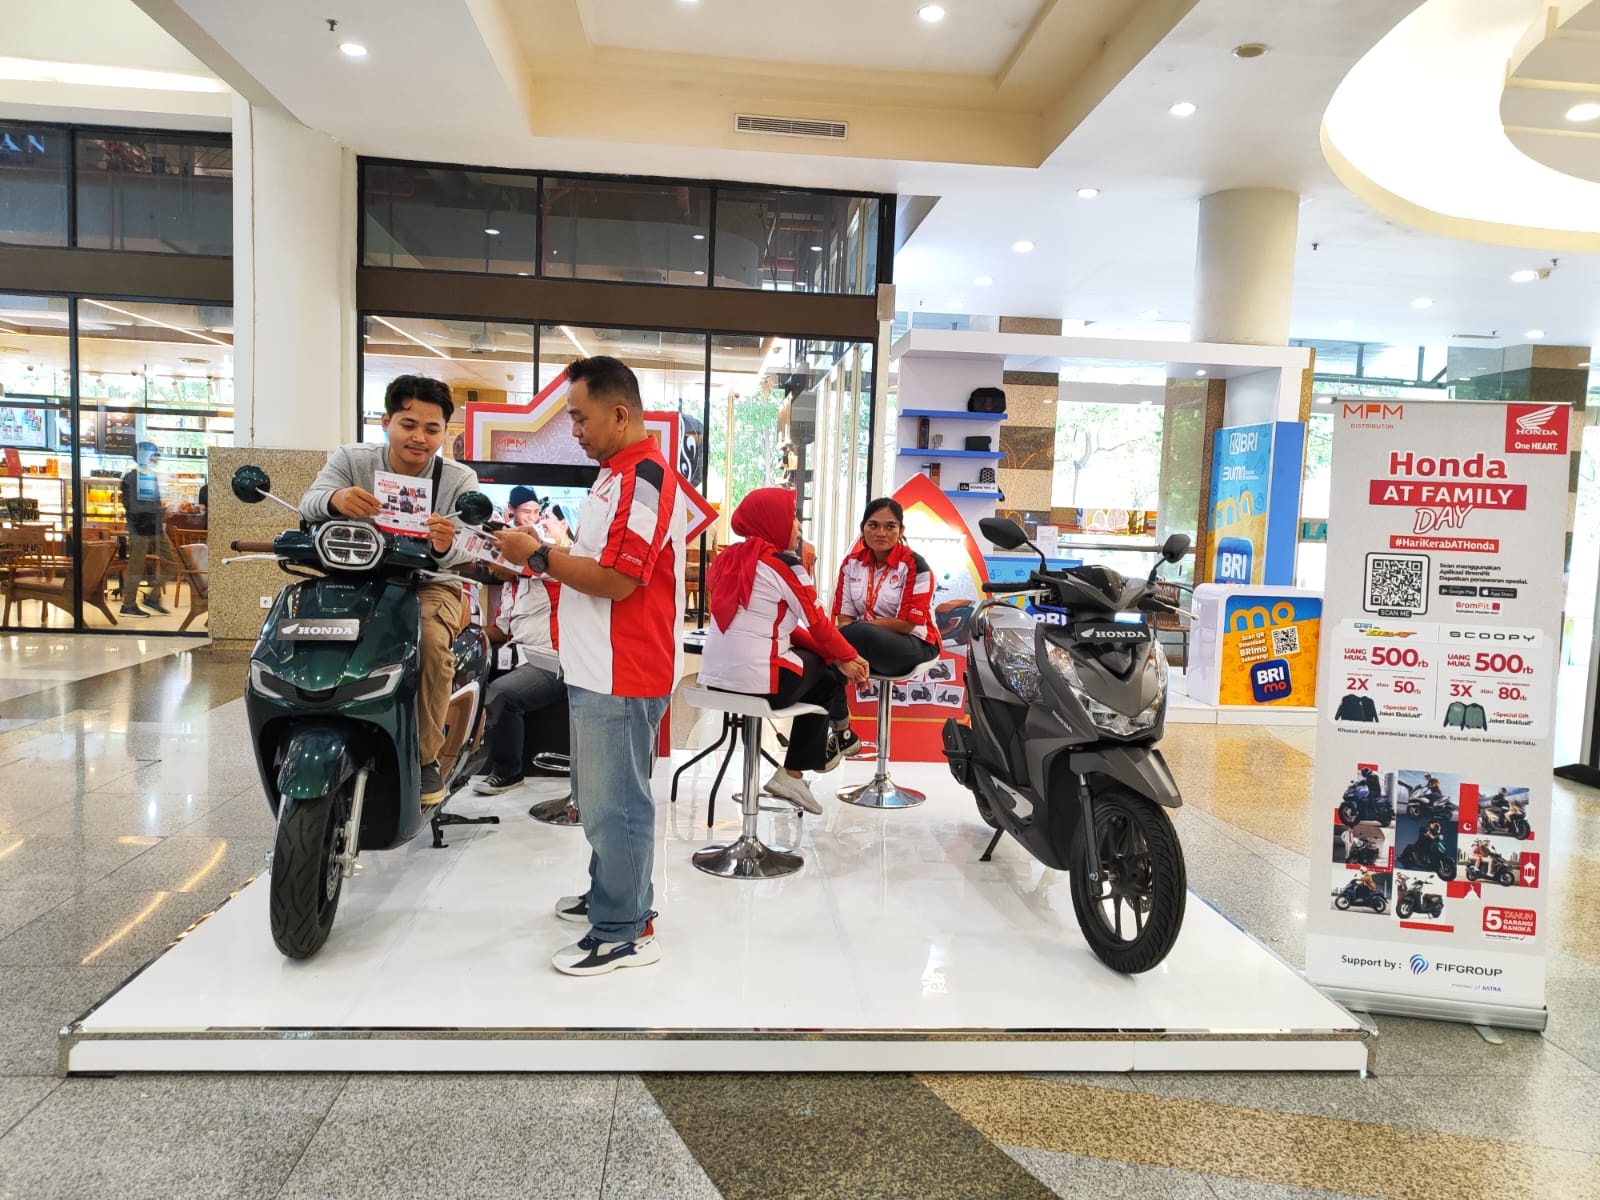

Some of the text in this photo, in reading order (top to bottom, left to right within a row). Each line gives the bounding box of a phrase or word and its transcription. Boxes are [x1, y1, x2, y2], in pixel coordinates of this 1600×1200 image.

[1343, 403, 1403, 420] MPM
[1240, 432, 1258, 453] BRI
[1515, 441, 1558, 450] One HEART.
[1389, 451, 1508, 479] Honda
[1383, 485, 1513, 505] AT FAMILY
[1413, 504, 1473, 534] DAY
[1395, 538, 1495, 550] #HariKerabATHonda
[1221, 552, 1247, 580] BRI
[1456, 601, 1490, 609] BromPit
[1230, 601, 1295, 632] mo
[298, 626, 353, 635] HONDA
[1094, 630, 1147, 638] HONDA
[1450, 631, 1535, 642] SCOOPY
[1257, 666, 1285, 685] BRI
[1264, 681, 1287, 693] mo
[1346, 677, 1369, 691] 2X
[1450, 684, 1473, 697] 3X
[1485, 910, 1503, 930] 5
[1503, 911, 1534, 920] TAHUN
[1503, 919, 1534, 927] GARANSI
[1341, 954, 1382, 967] Support
[1384, 959, 1397, 970] by
[1436, 963, 1503, 977] FIFGROUP
